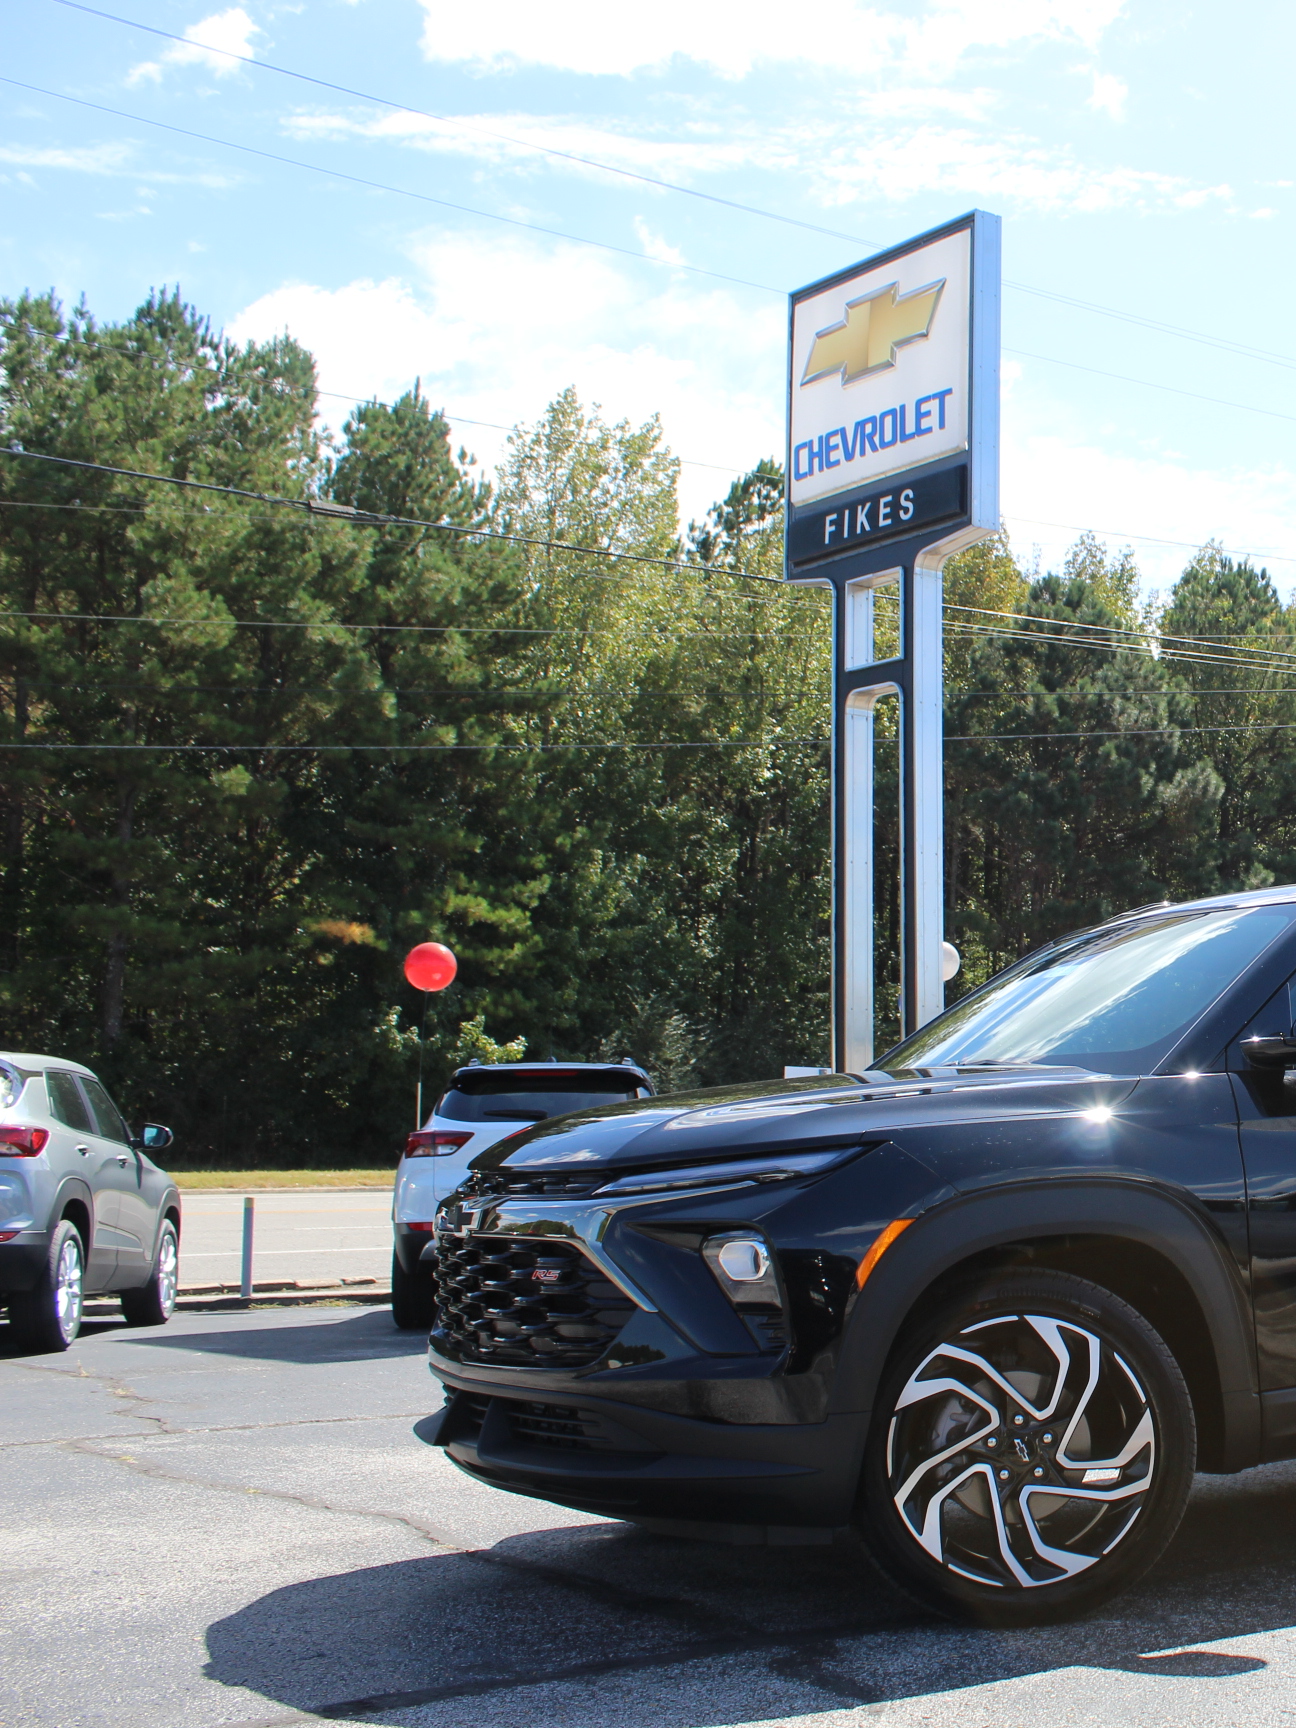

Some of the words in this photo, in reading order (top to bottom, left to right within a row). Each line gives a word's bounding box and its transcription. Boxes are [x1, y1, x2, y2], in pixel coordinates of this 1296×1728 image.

[794, 387, 953, 482] CHEVROLET
[824, 488, 914, 545] FIKES
[531, 1269, 560, 1281] RS
